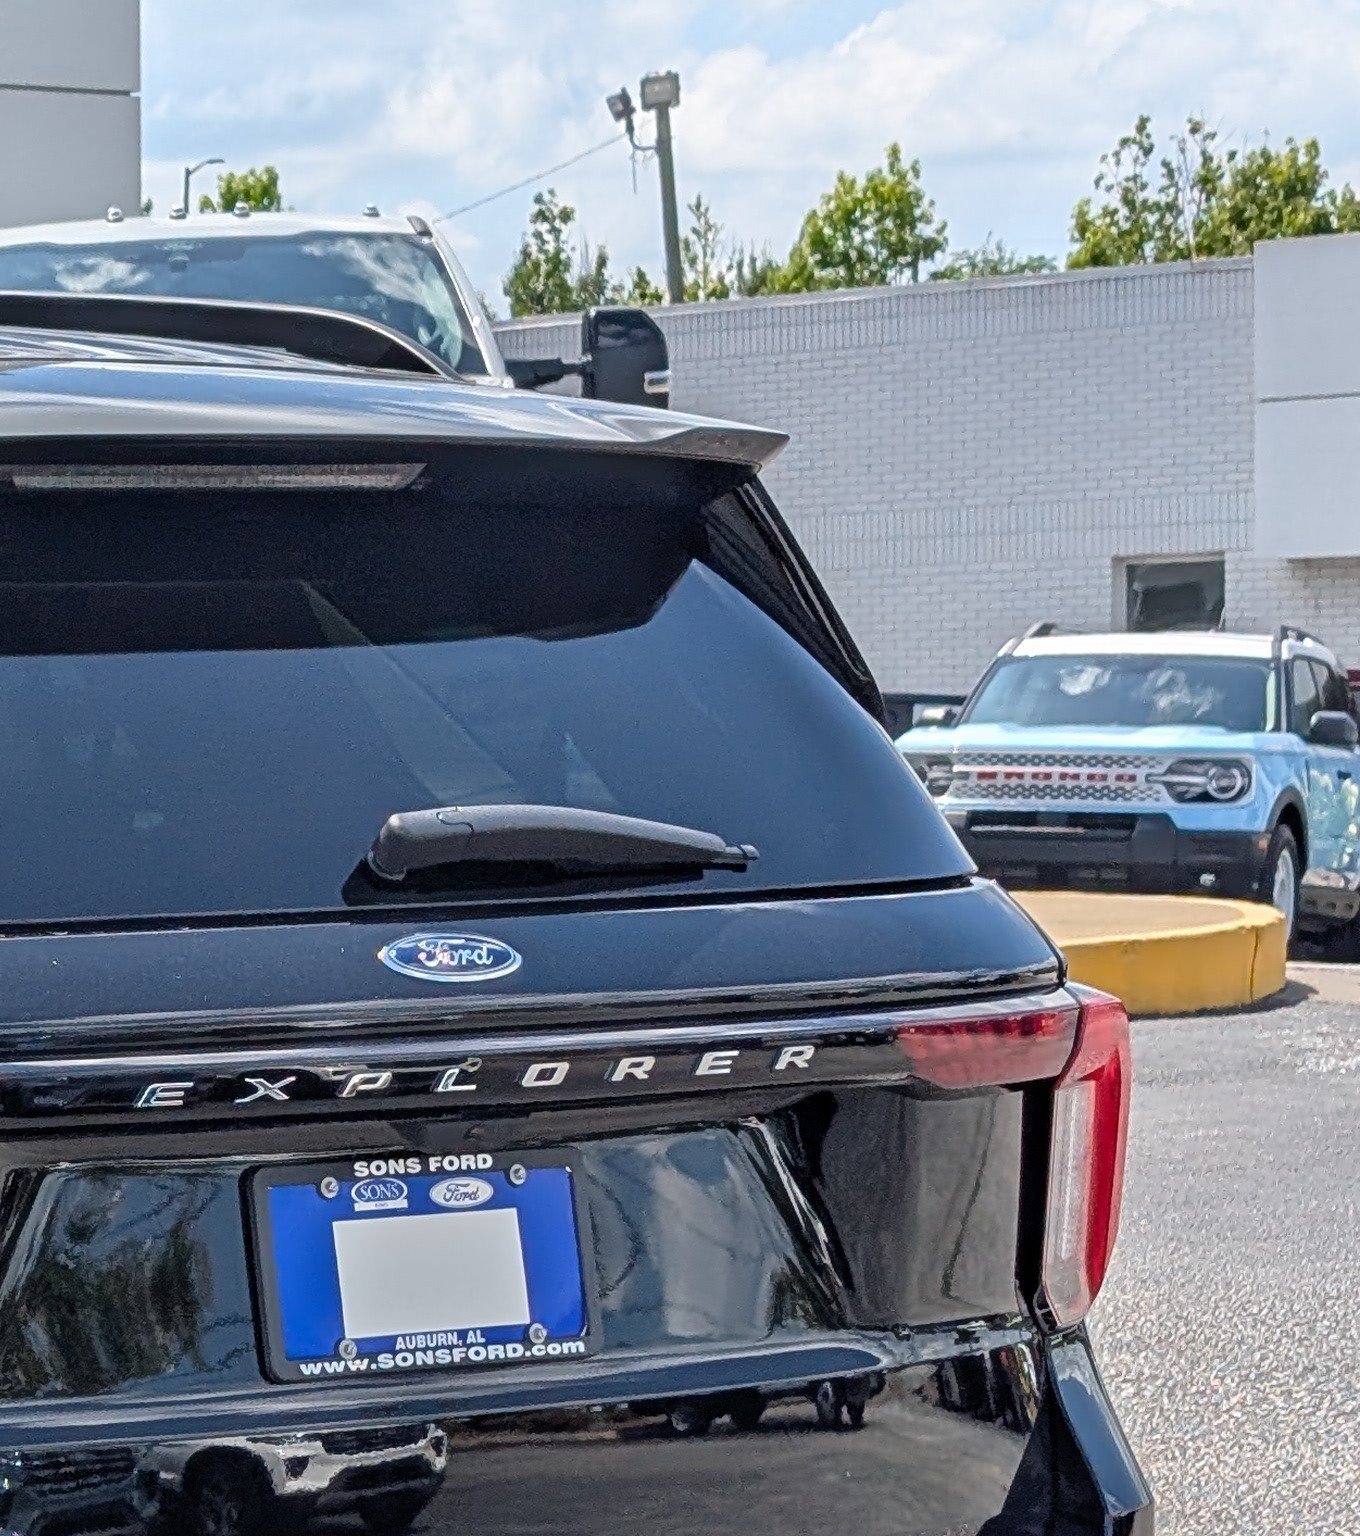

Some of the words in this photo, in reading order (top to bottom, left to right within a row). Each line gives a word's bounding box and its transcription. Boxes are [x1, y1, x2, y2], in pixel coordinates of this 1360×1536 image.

[417, 938, 494, 968] Ford
[133, 1044, 815, 1108] EXPLORER
[353, 1157, 422, 1178] SONS
[428, 1153, 494, 1173] FORD
[358, 1182, 401, 1201] SONS
[442, 1182, 481, 1202] Ford
[395, 1331, 463, 1351] AUBURN,
[467, 1329, 486, 1346] AL
[299, 1339, 585, 1375] www.SONSFORD.com
